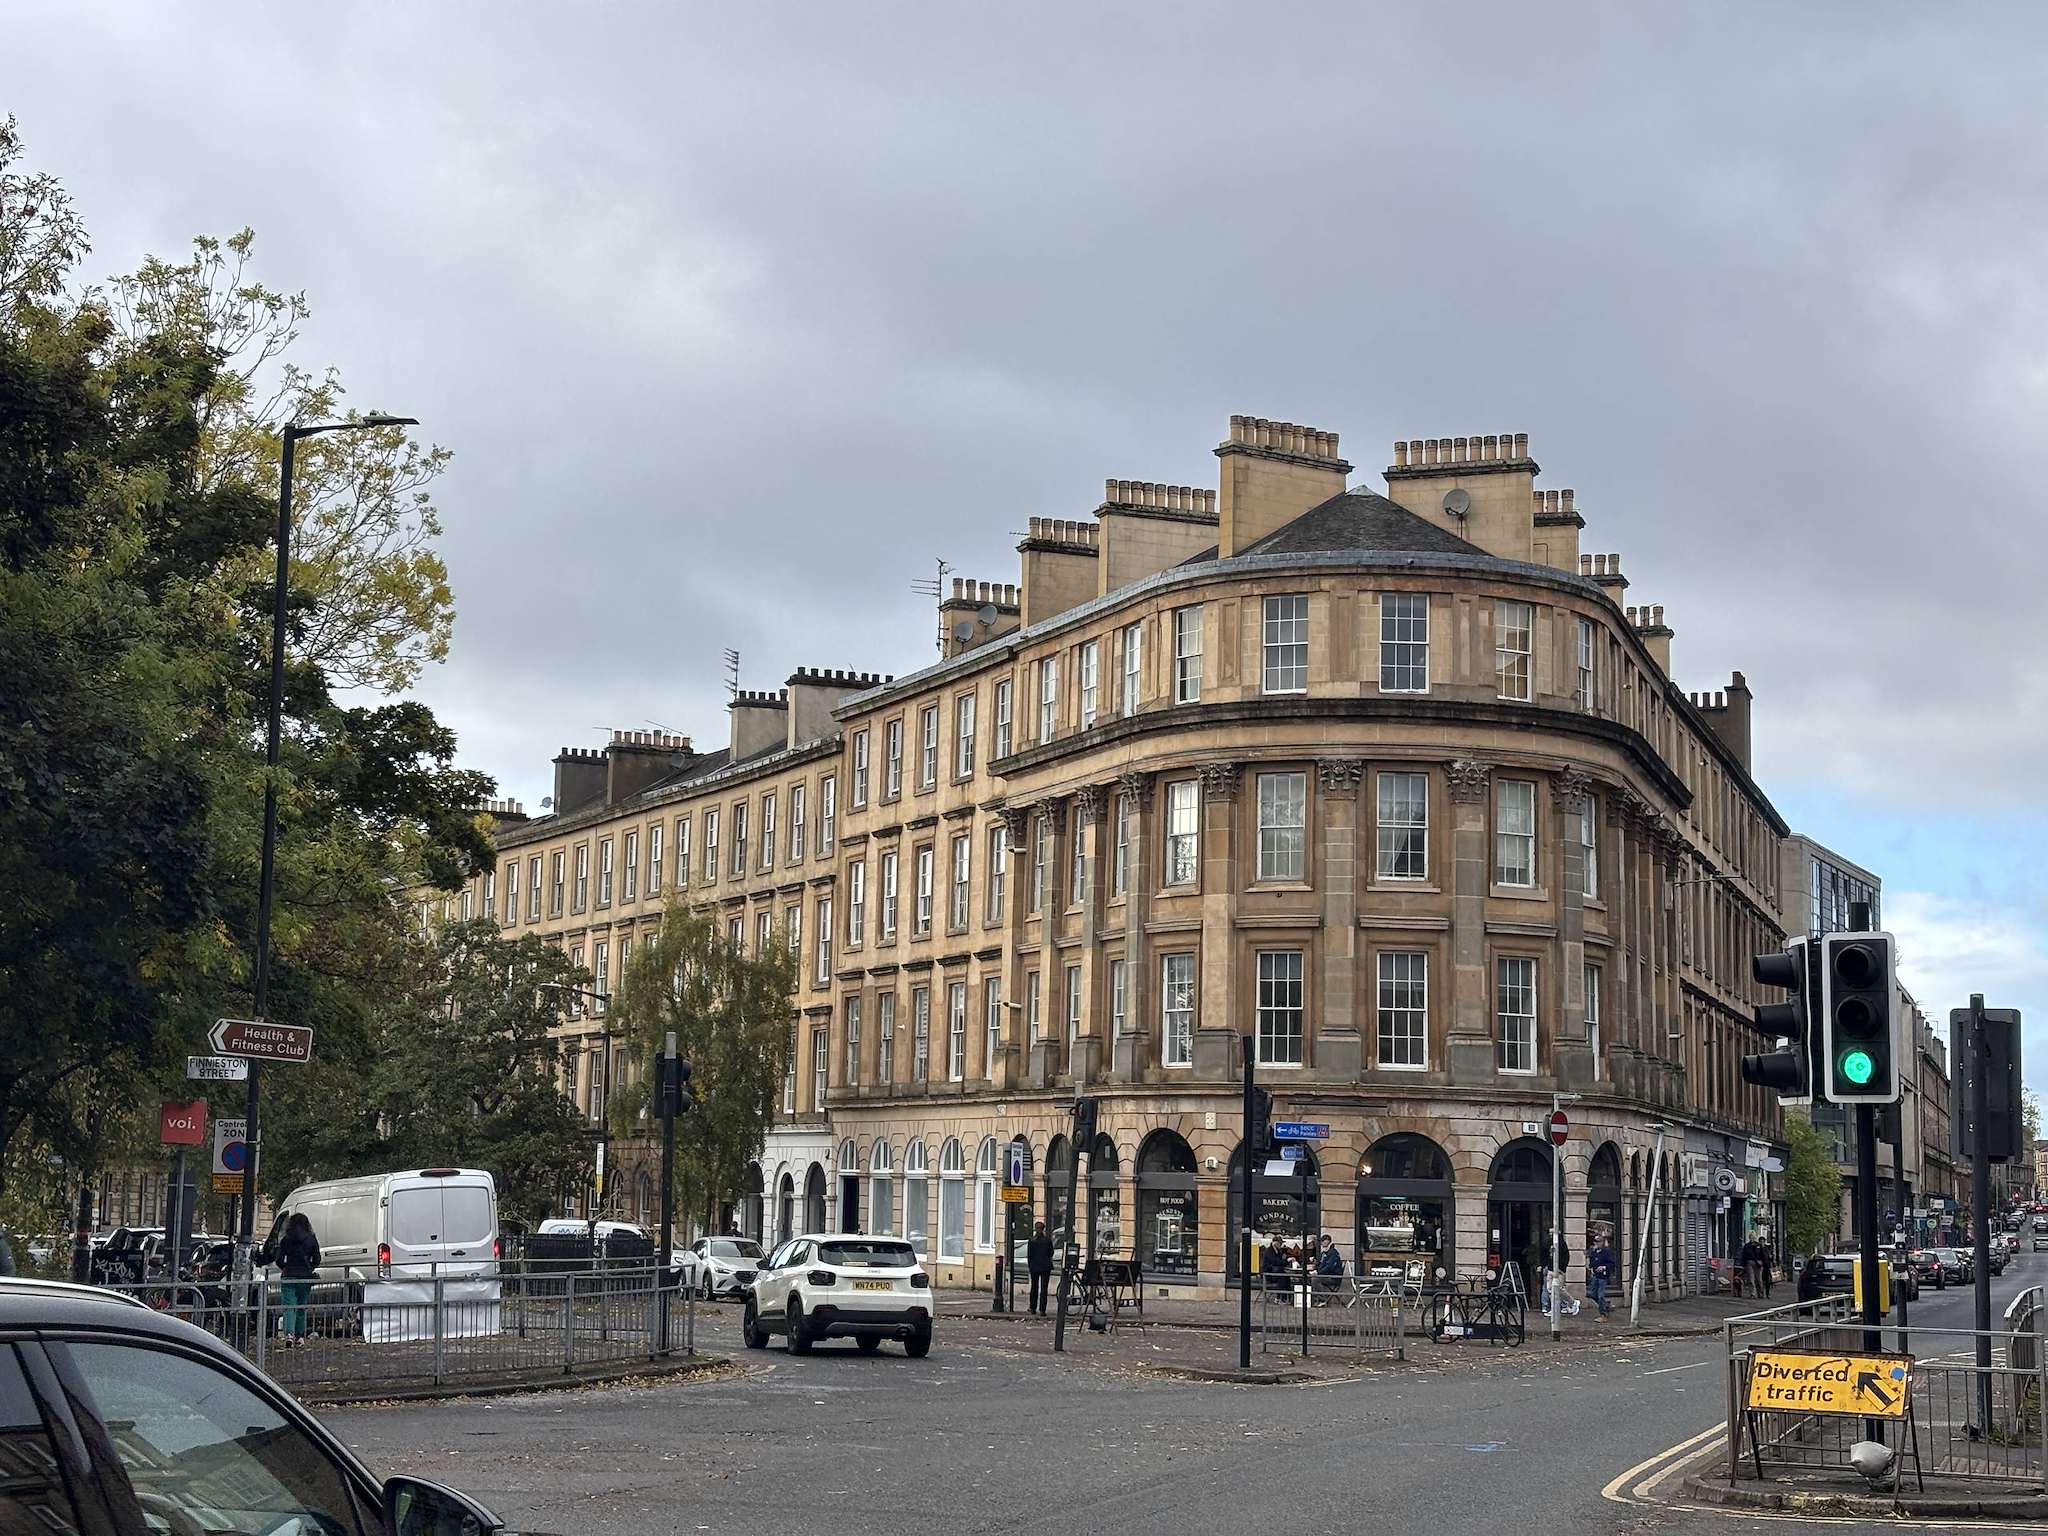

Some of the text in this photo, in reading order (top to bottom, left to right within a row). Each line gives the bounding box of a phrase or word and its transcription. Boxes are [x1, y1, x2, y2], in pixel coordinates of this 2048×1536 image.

[244, 1028, 295, 1042] Health &
[231, 1038, 305, 1056] Fitness Club
[189, 1058, 247, 1068] FINNIESTON
[199, 1068, 236, 1078] STREET
[167, 1117, 196, 1129] voi.
[223, 1129, 245, 1138] ZON
[1262, 1198, 1290, 1206] BAKERY
[1259, 1212, 1294, 1222] SUNDAYS
[1757, 1362, 1848, 1382] Diverted
[1766, 1383, 1834, 1402] traffic
